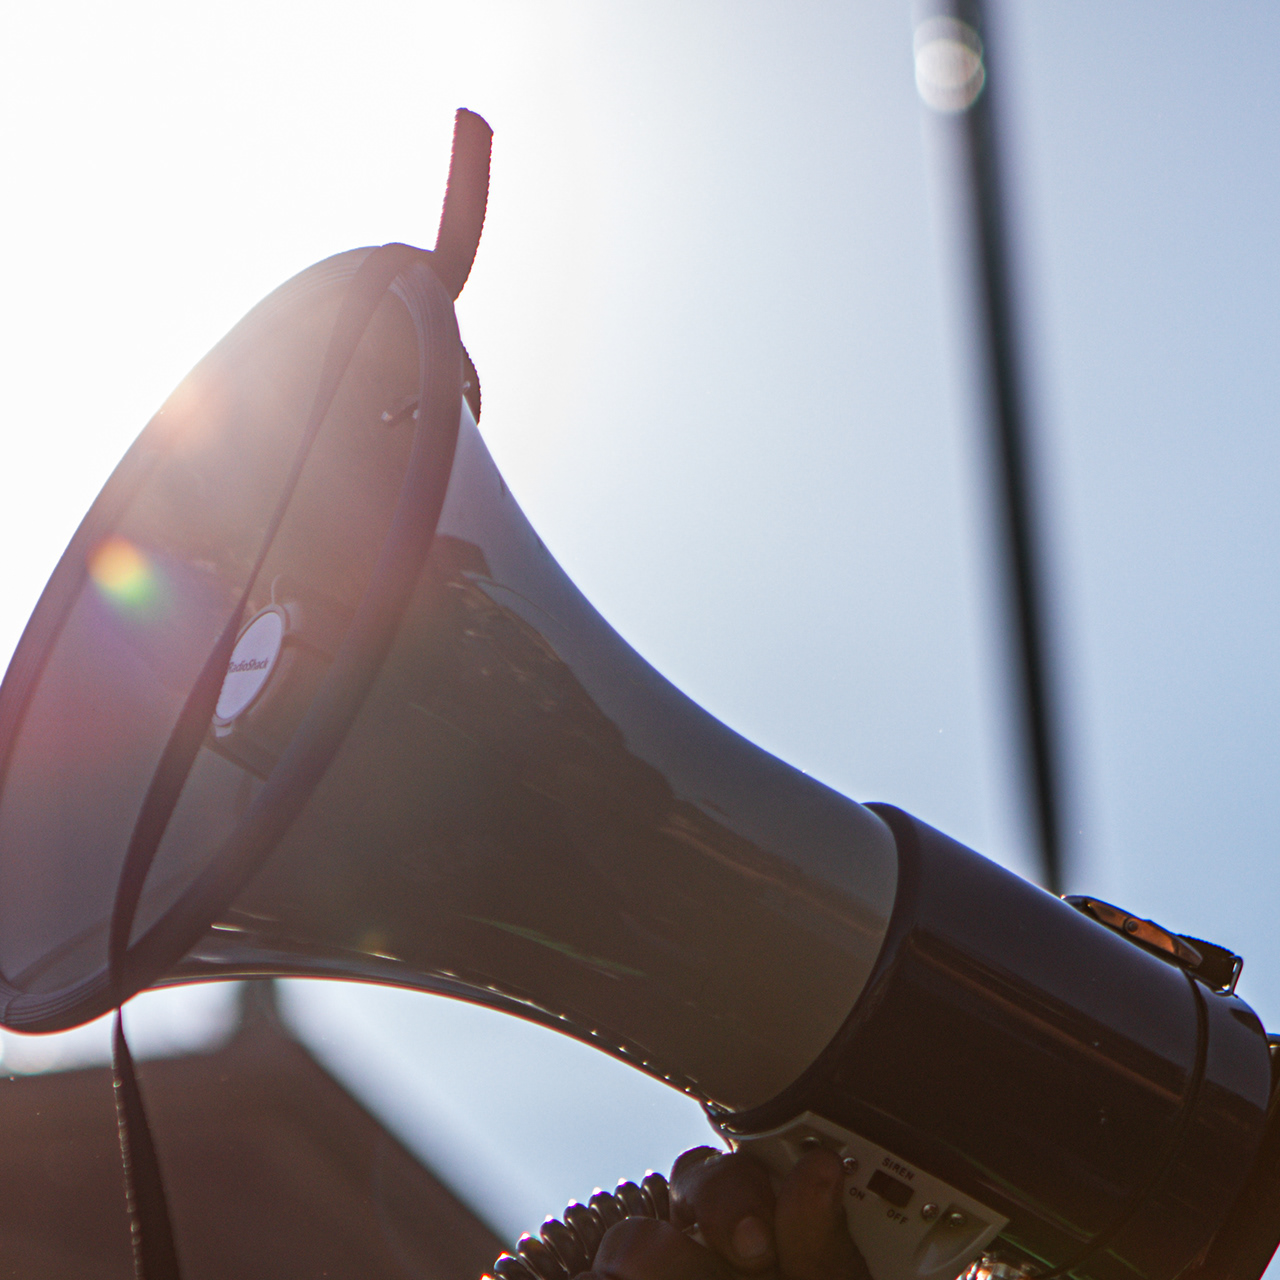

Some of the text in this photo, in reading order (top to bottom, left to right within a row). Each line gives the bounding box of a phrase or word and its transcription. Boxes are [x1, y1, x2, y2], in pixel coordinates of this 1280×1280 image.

[881, 1157, 915, 1180] SIREN
[849, 1187, 866, 1201] ON
[886, 1208, 909, 1225] OFF
